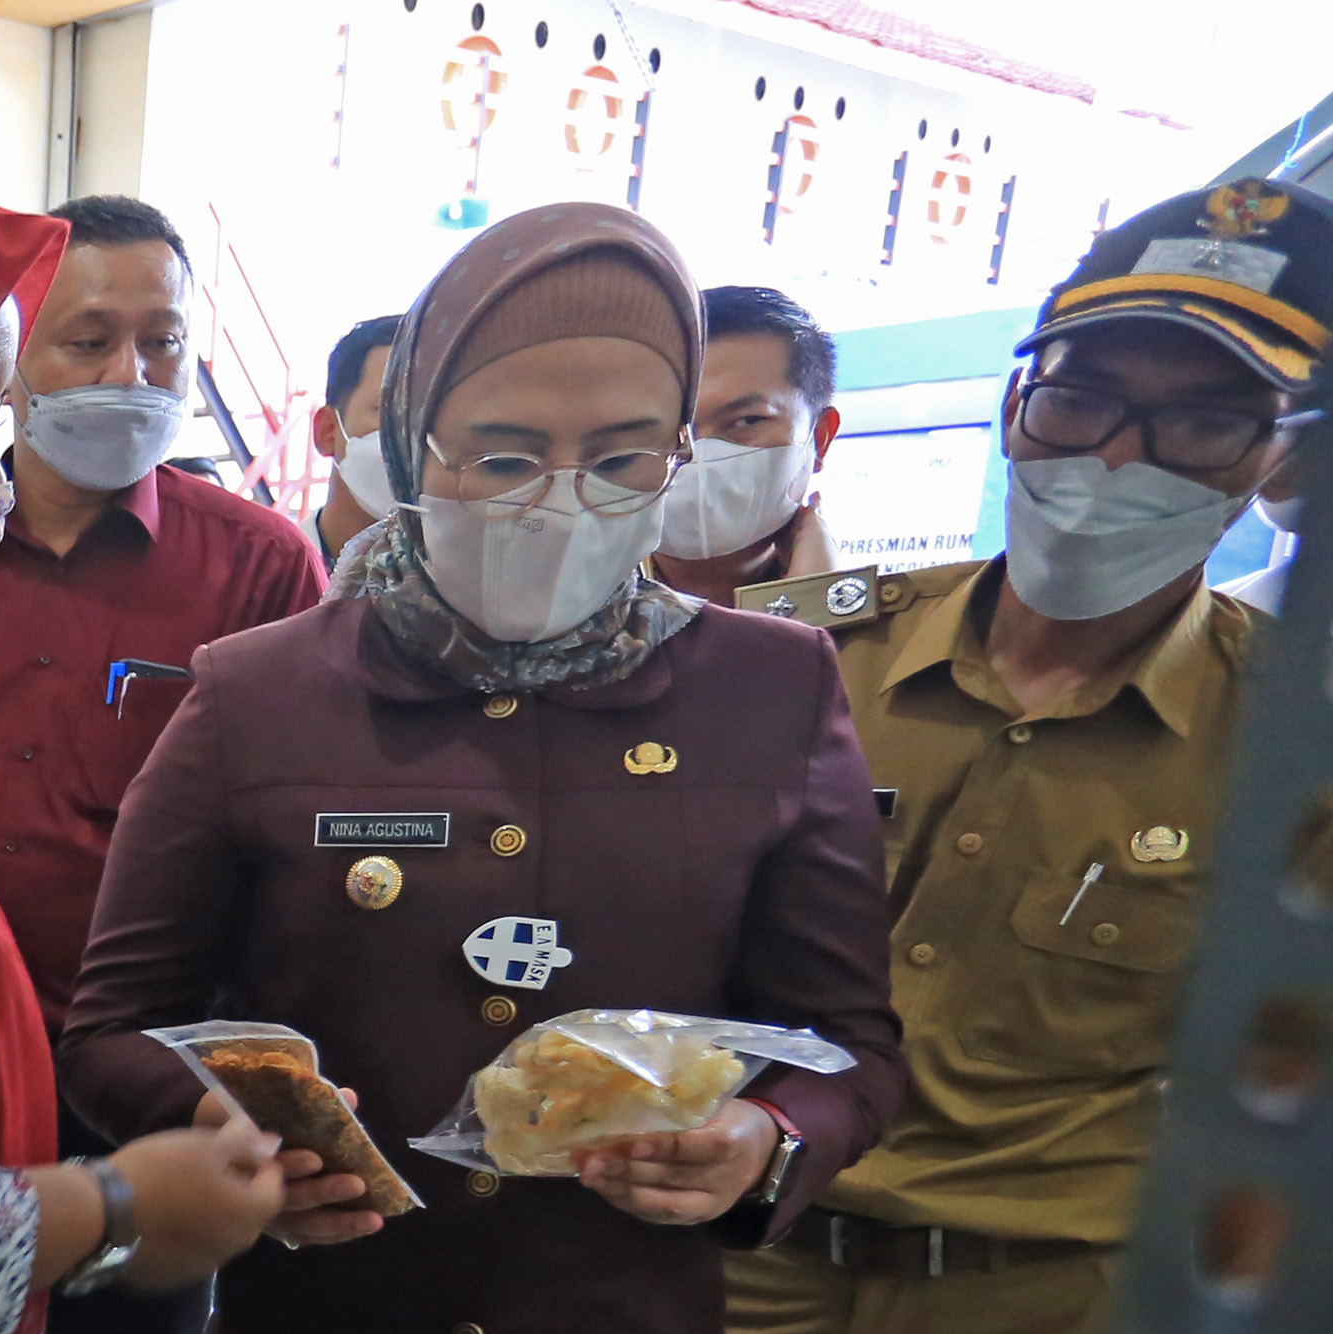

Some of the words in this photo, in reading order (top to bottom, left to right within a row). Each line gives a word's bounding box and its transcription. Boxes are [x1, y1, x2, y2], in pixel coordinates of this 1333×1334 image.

[840, 536, 929, 555] PERESMIAN
[329, 823, 362, 836] NINA
[365, 823, 434, 837] AGUSTINA
